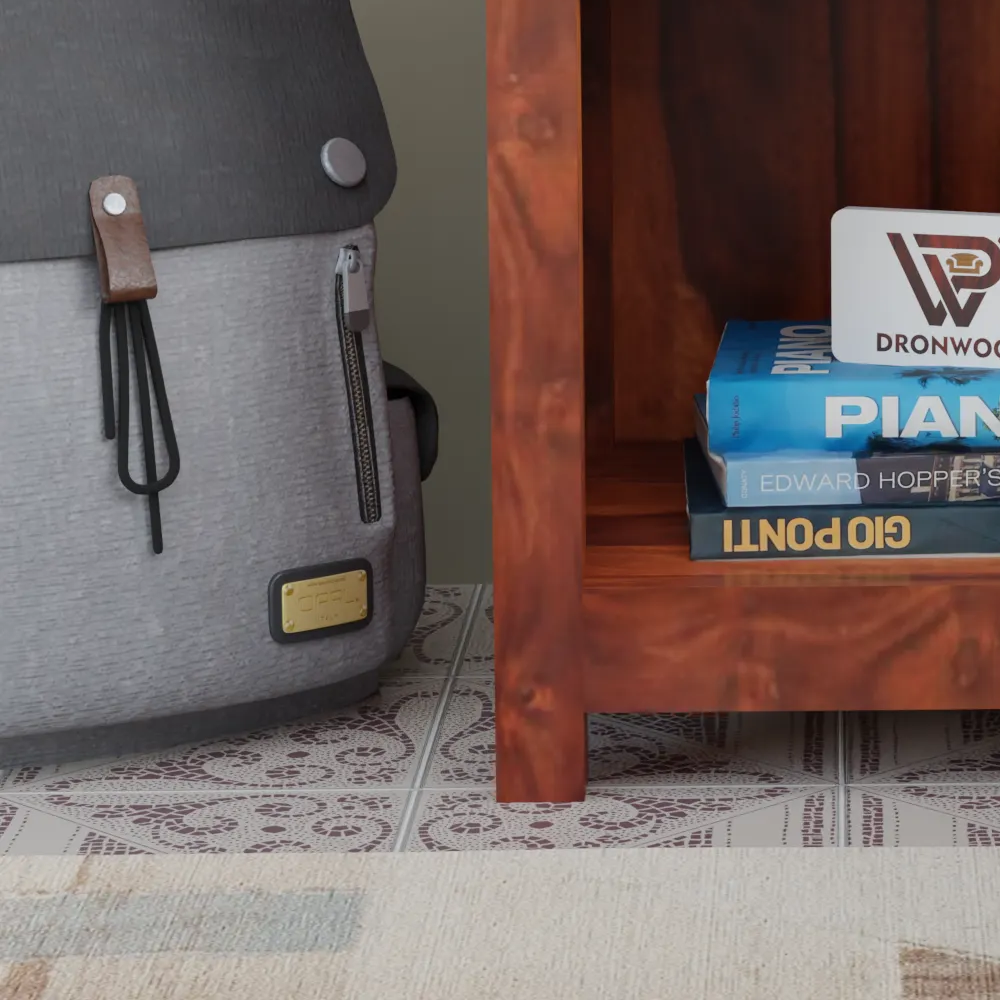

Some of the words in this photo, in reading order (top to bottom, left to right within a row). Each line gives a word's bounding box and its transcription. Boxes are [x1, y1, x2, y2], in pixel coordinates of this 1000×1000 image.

[770, 324, 831, 375] PIANO
[760, 472, 870, 493] EDWARD
[723, 517, 841, 553] PONTI
[847, 515, 912, 550] GIO
